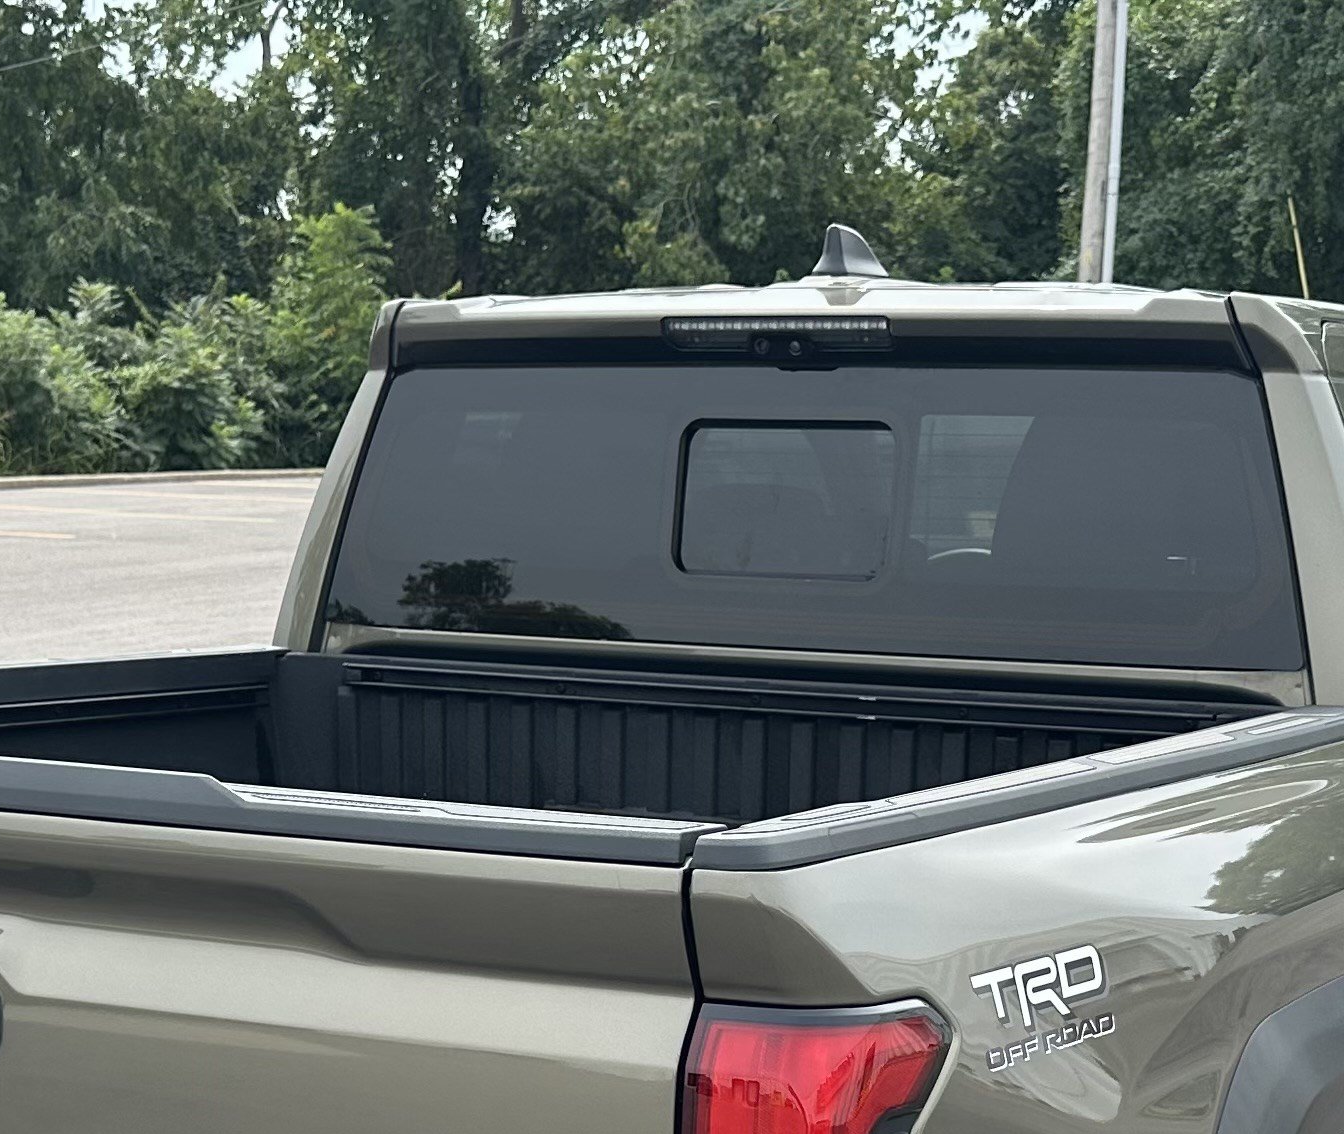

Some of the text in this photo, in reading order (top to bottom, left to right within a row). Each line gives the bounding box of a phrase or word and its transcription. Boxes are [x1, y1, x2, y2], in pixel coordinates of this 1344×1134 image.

[969, 943, 1106, 1033] TRD
[986, 1012, 1116, 1073] OFF ROAD
